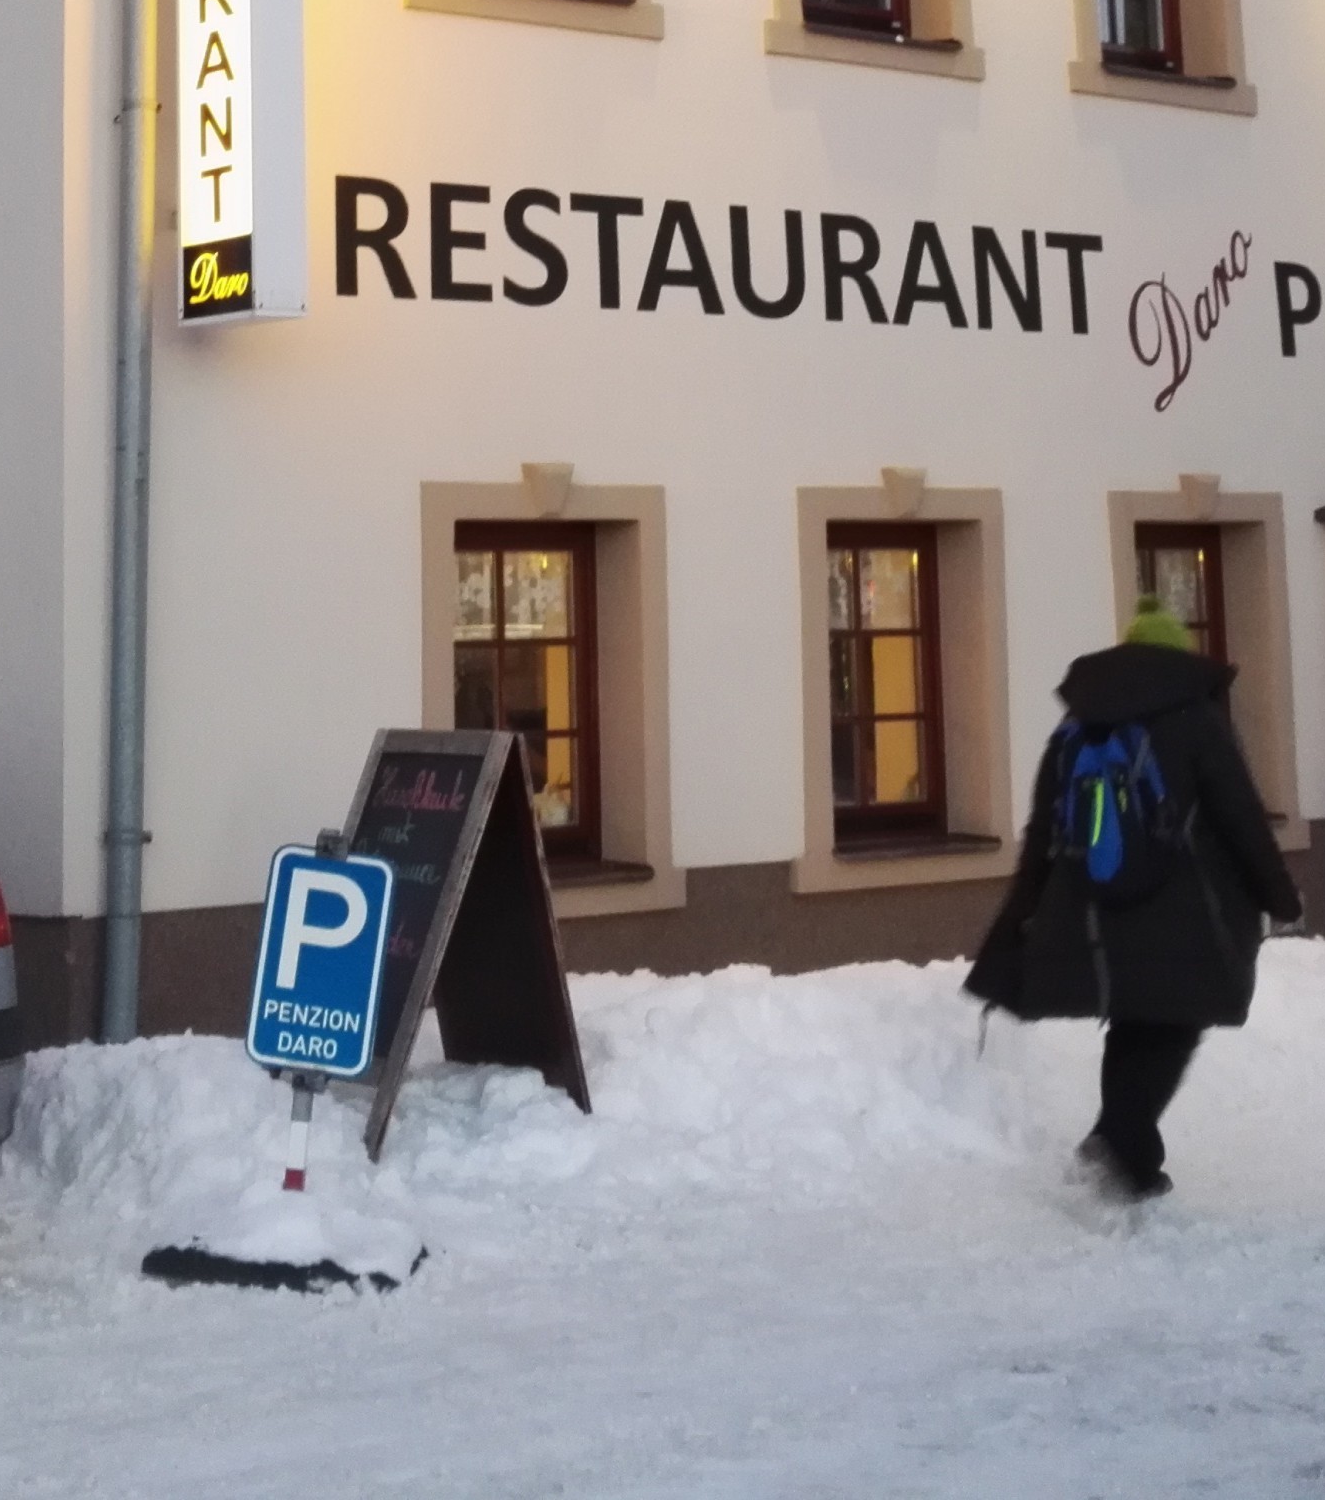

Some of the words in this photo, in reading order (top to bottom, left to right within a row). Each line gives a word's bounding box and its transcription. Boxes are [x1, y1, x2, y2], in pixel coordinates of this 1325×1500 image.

[190, 252, 249, 305] Daro
[333, 175, 1104, 336] RESTAURANT
[1128, 229, 1254, 414] Daro
[275, 867, 368, 990] P
[263, 999, 361, 1034] PENZION
[277, 1030, 338, 1060] DARO
